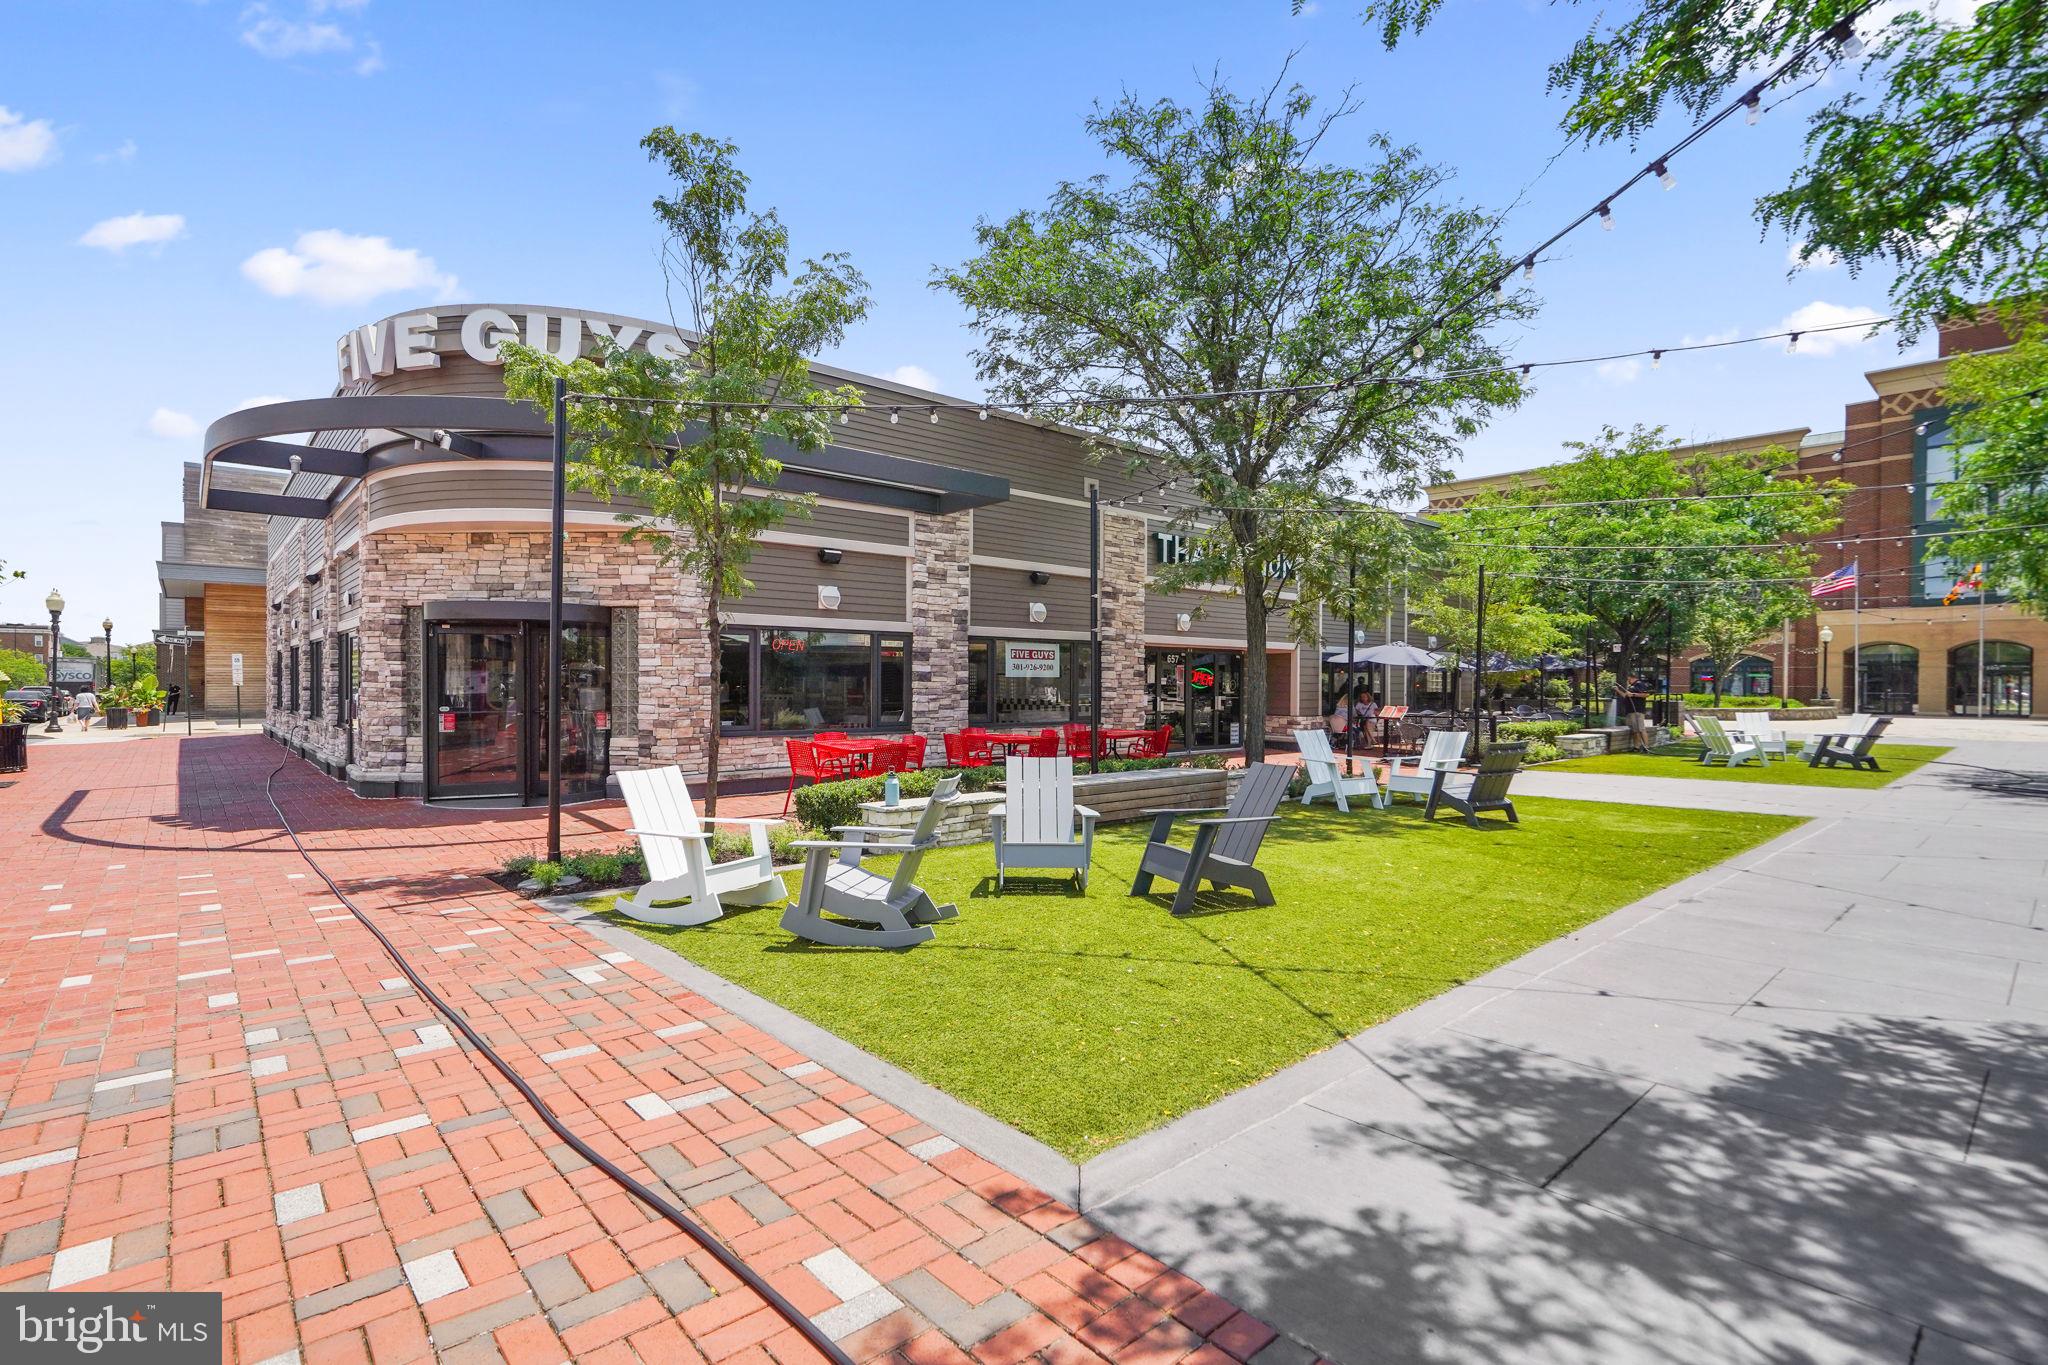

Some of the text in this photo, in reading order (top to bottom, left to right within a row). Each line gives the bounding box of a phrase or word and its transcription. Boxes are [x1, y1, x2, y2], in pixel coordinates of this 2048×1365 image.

[337, 313, 441, 389] FIVE
[772, 639, 806, 652] OPEN
[1011, 650, 1055, 659] FIVE GUYS
[1166, 654, 1180, 664] 657
[1011, 663, 1054, 671] 301-926-9200
